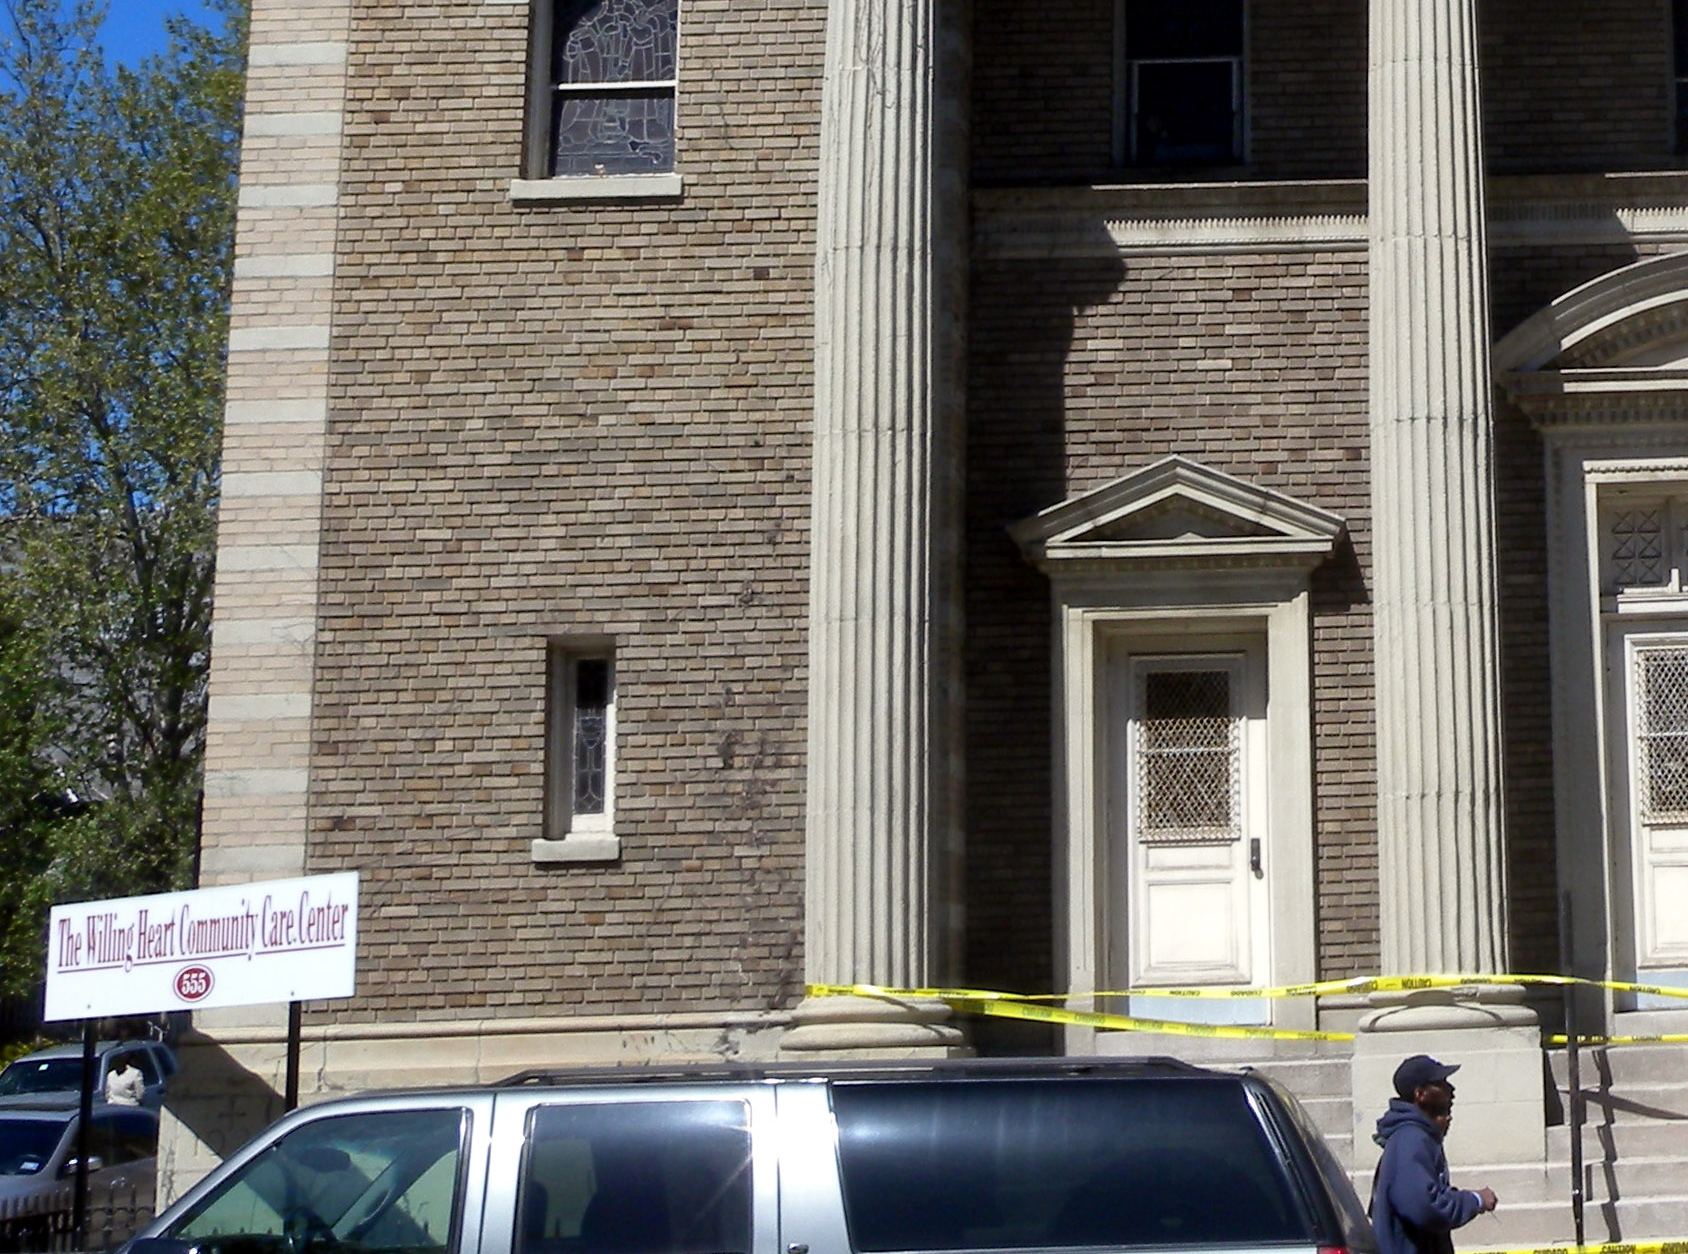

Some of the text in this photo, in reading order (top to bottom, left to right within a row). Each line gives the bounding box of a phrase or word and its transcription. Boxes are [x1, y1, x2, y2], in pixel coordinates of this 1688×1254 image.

[57, 890, 349, 973] The Willing Heart Community Care Center
[181, 972, 207, 995] 555
